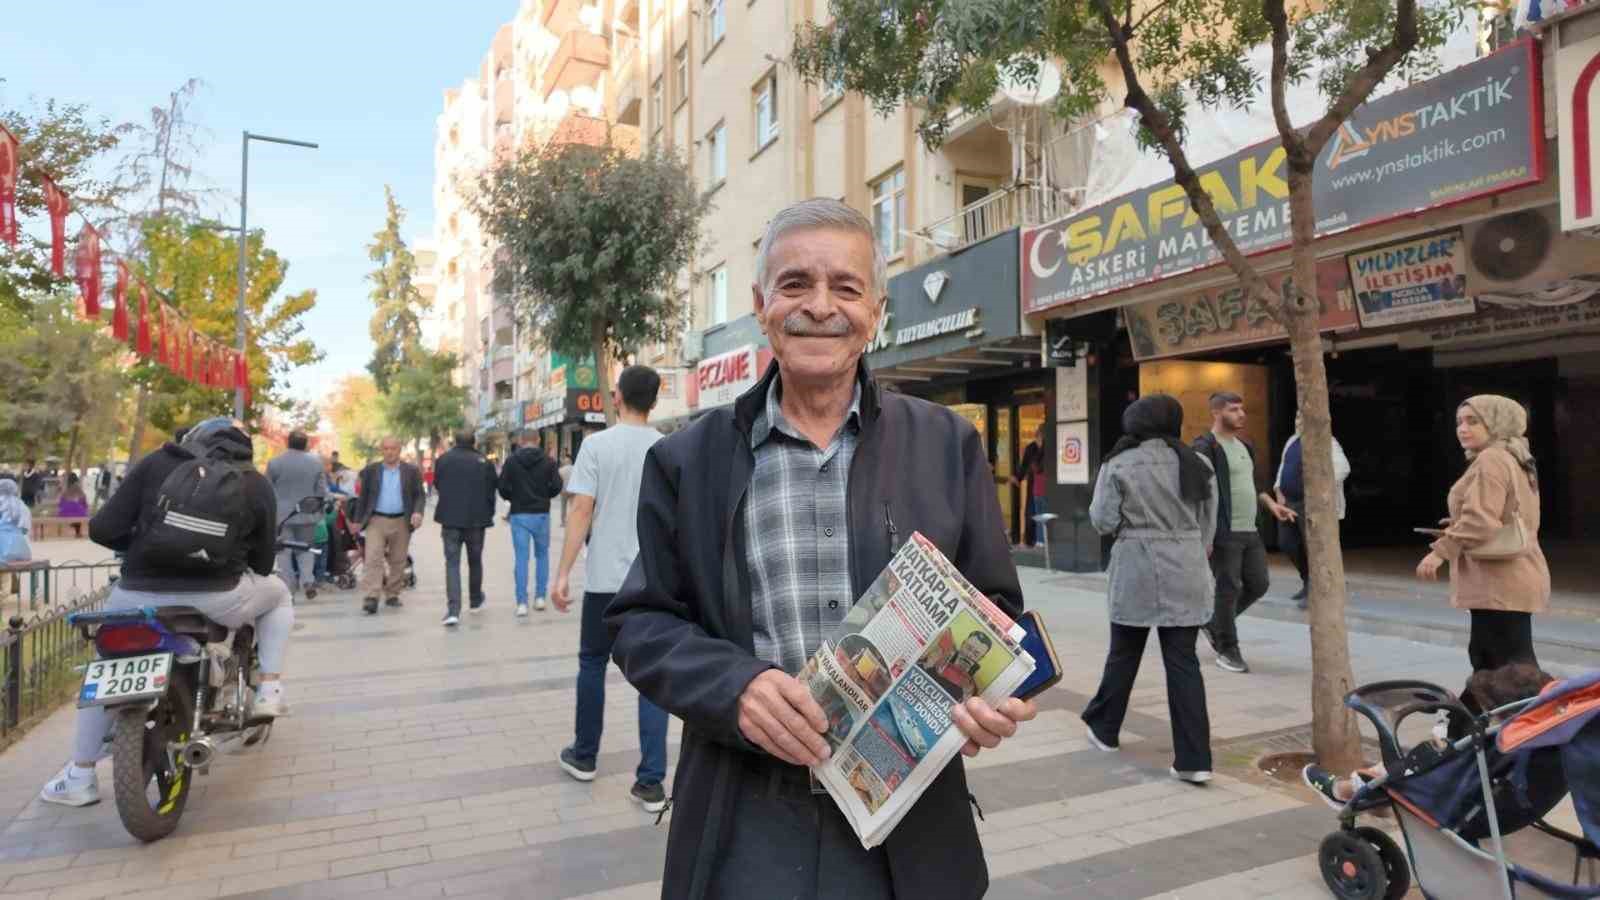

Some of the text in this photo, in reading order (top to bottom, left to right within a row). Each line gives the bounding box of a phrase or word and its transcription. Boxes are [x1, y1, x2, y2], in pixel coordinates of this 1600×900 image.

[1331, 127, 1506, 190] www.ynstaktik.com
[896, 307, 977, 346] KUYUMCULUK
[699, 350, 751, 391] ECZANE
[105, 676, 148, 696] 208
